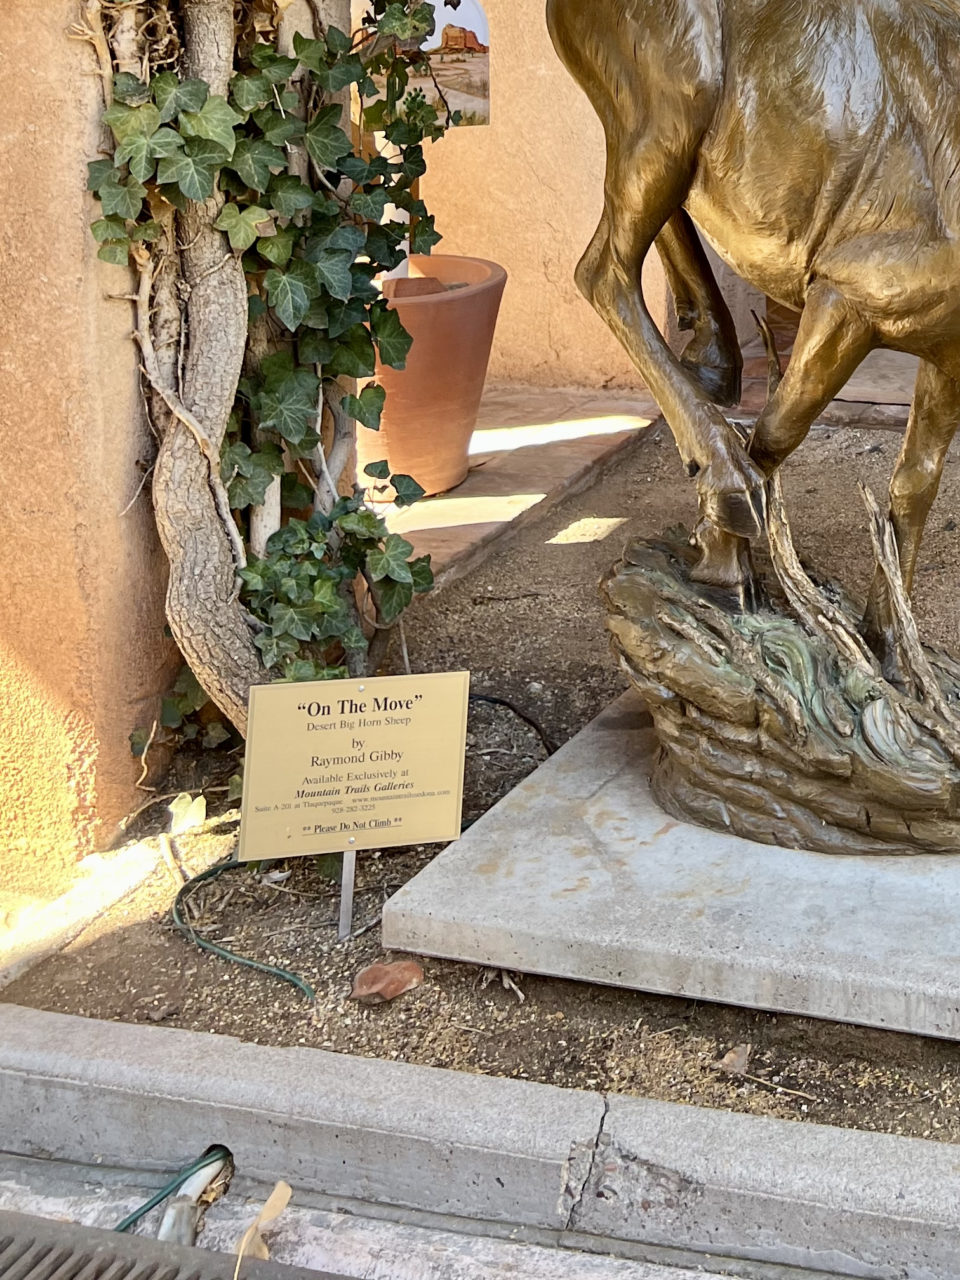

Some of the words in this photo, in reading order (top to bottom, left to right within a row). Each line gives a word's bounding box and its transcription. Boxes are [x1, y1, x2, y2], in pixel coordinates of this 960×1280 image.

[297, 701, 331, 717] “On
[337, 699, 367, 714] The
[372, 694, 423, 712] Move”
[306, 722, 336, 731] Desert
[340, 719, 355, 730] Big
[358, 718, 382, 728] Horn
[384, 716, 411, 726] Sheep
[351, 738, 365, 751] by
[310, 753, 365, 769] Raymond
[369, 750, 404, 763] Gibby
[301, 774, 344, 785] Available
[346, 769, 397, 782] Exclusively
[295, 787, 341, 799] Mountain
[344, 783, 370, 795] Trails
[373, 781, 415, 792] Galleries
[314, 824, 337, 834] Please
[340, 822, 350, 831] Do
[353, 821, 366, 830] Not
[369, 818, 392, 828] Climb
